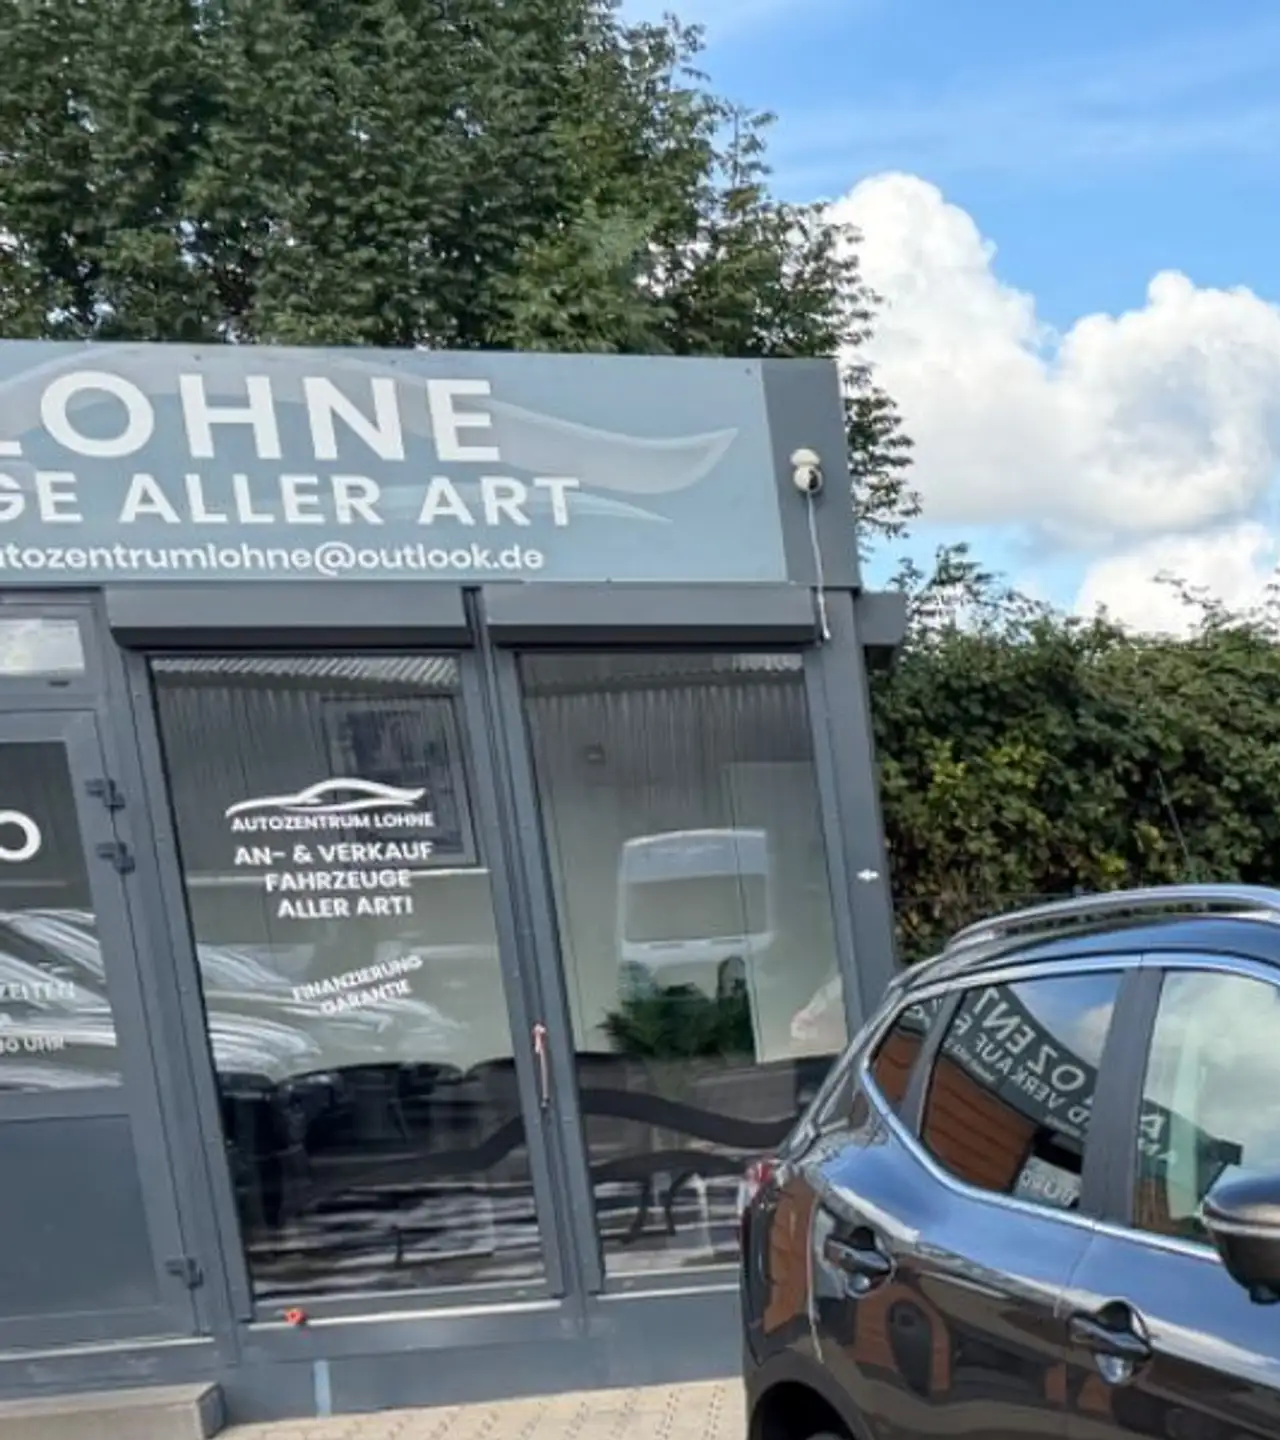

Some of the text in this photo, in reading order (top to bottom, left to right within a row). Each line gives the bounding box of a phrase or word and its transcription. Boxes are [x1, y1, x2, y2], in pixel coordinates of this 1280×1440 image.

[119, 473, 384, 525] ALLER
[418, 476, 580, 527] ART
[0, 541, 544, 577] tozentrumlohne@outlook.de
[230, 812, 435, 832] AUTOZENTRUM LOHNE
[234, 842, 433, 866] AN- & VERKAUF
[265, 869, 411, 892] FAHRZEUGE
[277, 898, 350, 918] ALLER
